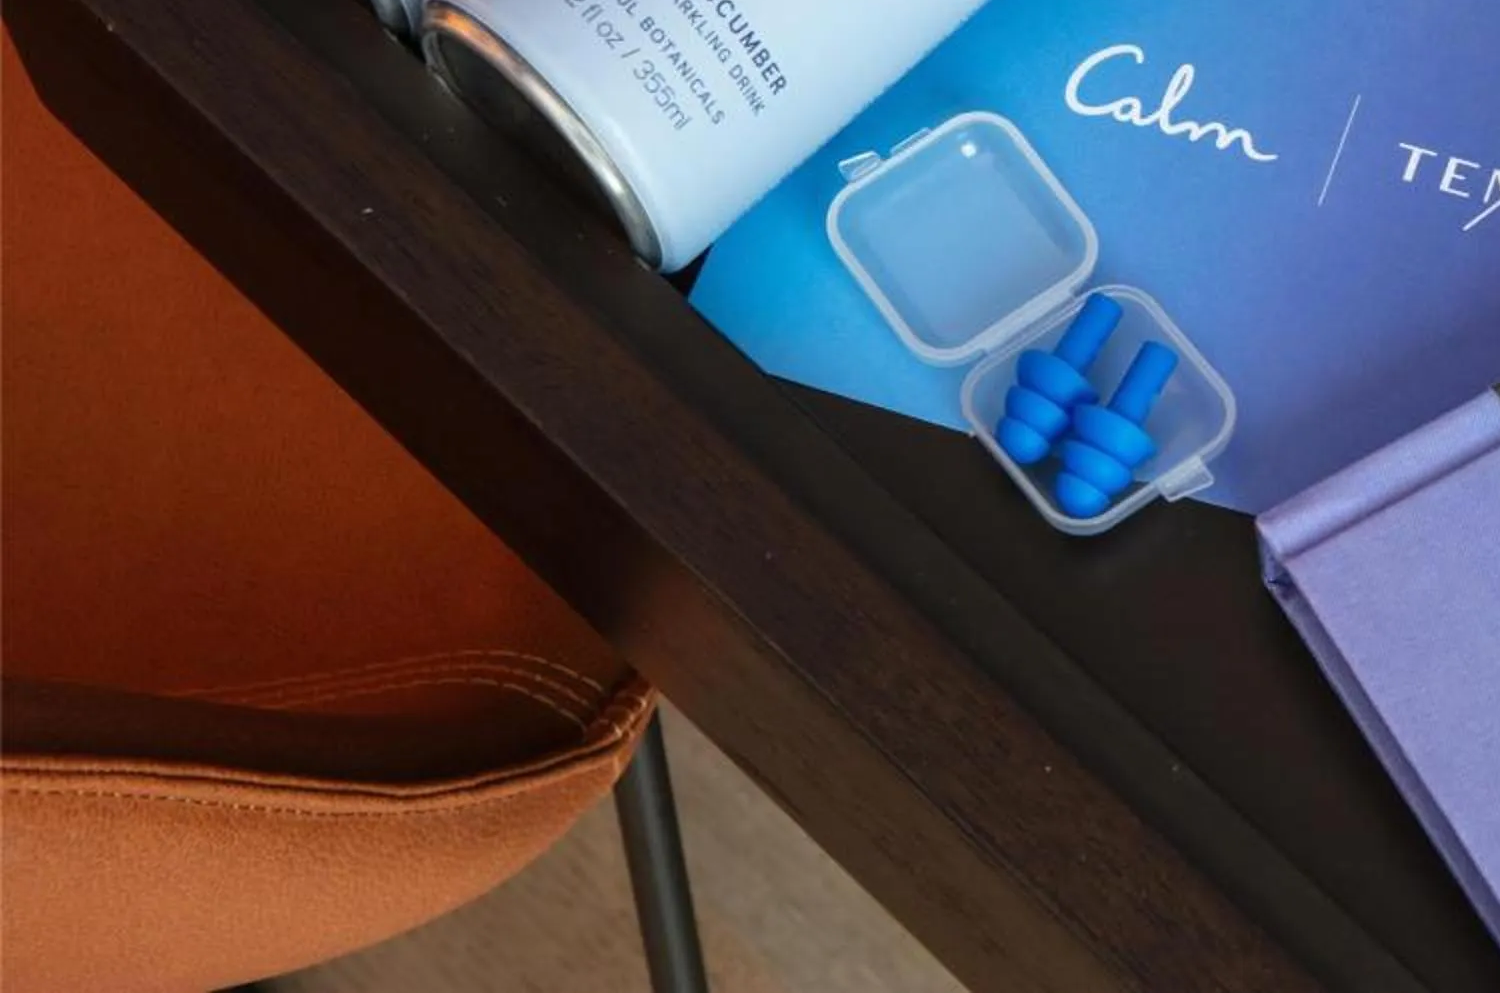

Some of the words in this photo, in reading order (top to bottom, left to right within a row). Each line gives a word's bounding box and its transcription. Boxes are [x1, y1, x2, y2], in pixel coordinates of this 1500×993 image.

[581, 3, 604, 24] fl
[596, 21, 625, 50] oz
[621, 48, 641, 59] /
[633, 59, 693, 131] 355ml
[640, 16, 725, 125] BOTANICALS
[728, 64, 765, 117] DRINK
[1064, 43, 1278, 161] Calm
